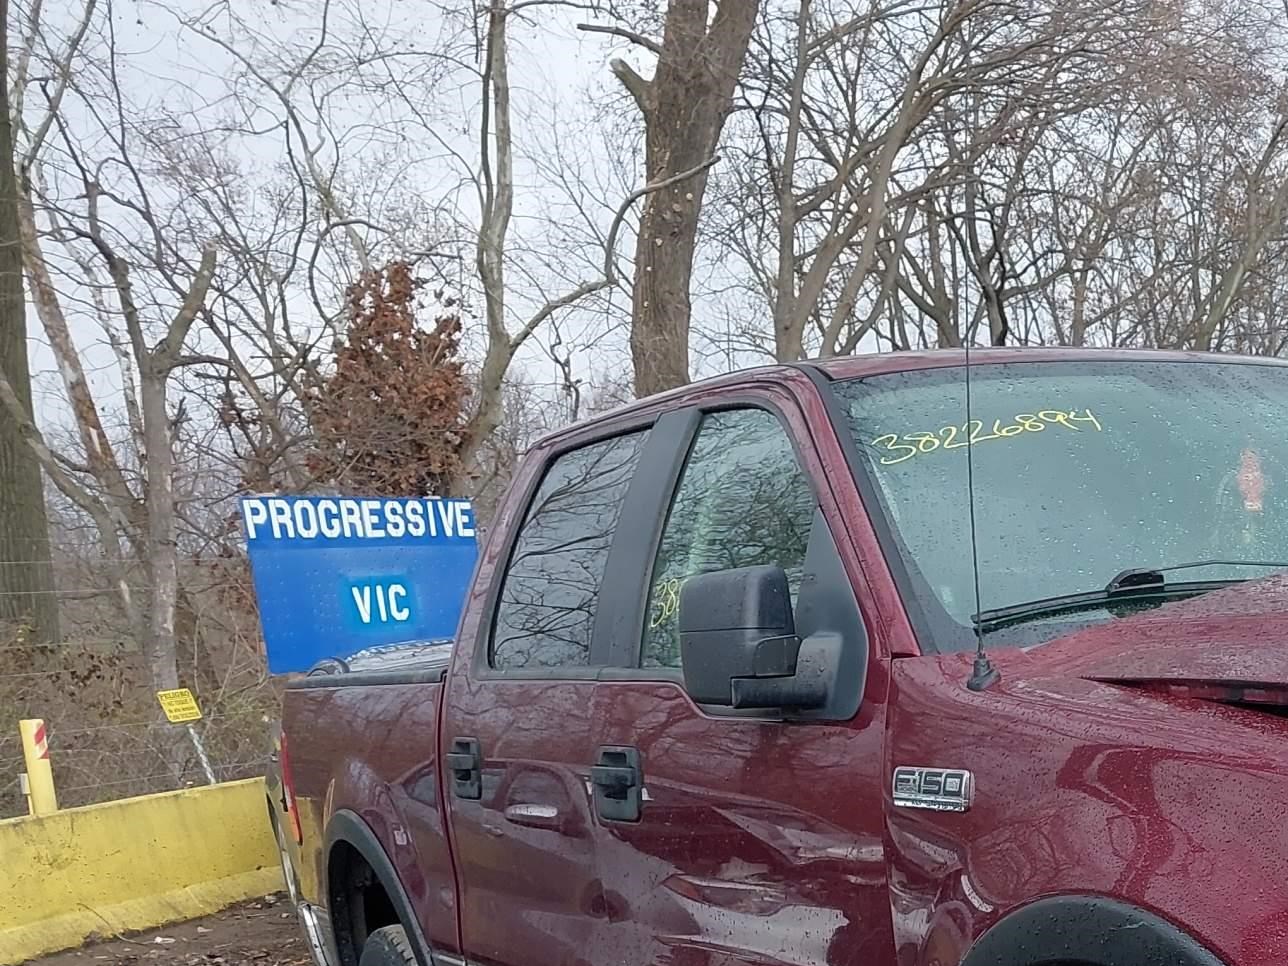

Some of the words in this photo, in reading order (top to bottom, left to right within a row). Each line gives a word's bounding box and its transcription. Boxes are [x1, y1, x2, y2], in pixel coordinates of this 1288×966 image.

[870, 408, 1102, 465] 38226894
[242, 499, 475, 540] PROGRESSIVE
[351, 583, 411, 624] VIC
